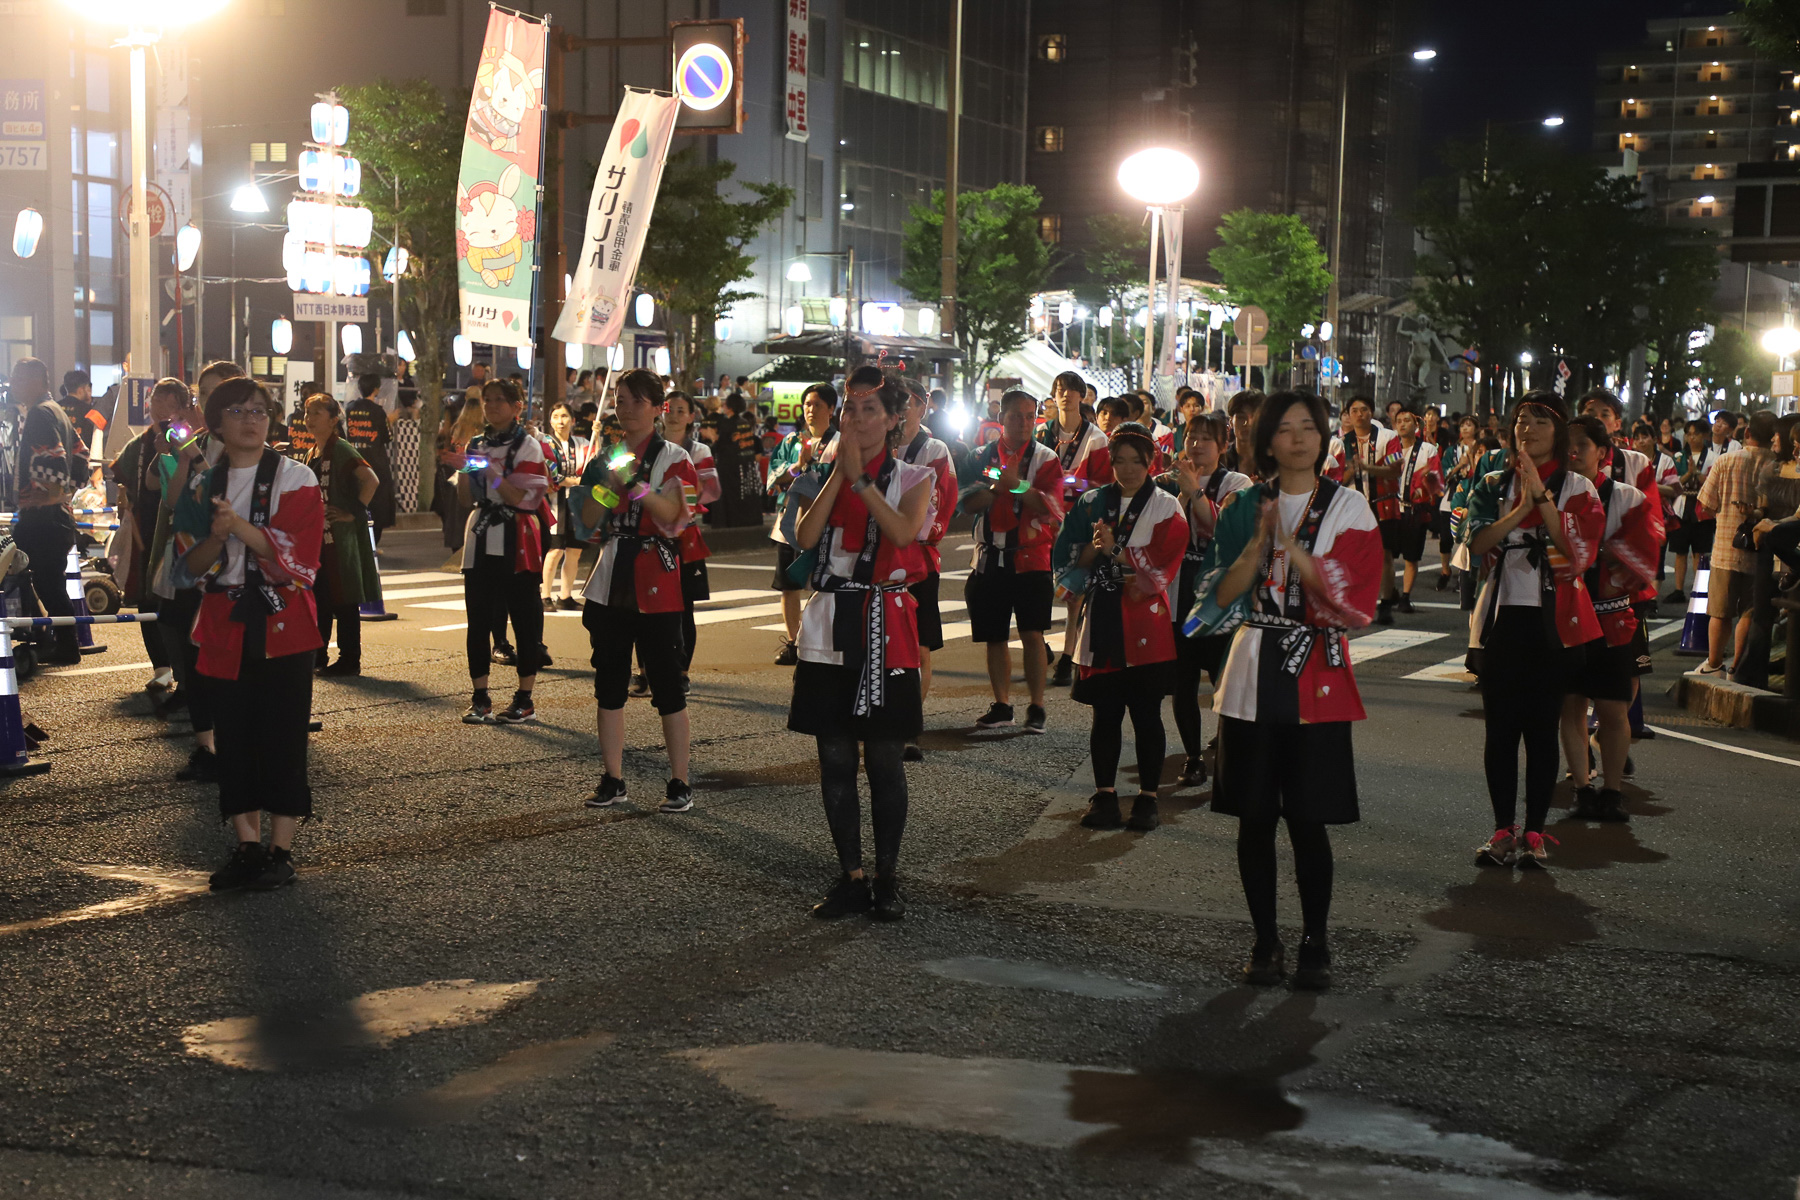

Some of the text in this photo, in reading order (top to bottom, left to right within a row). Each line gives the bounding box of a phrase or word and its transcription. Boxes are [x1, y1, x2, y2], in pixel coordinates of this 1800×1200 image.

[296, 303, 366, 316] NTT西日本静岡支店
